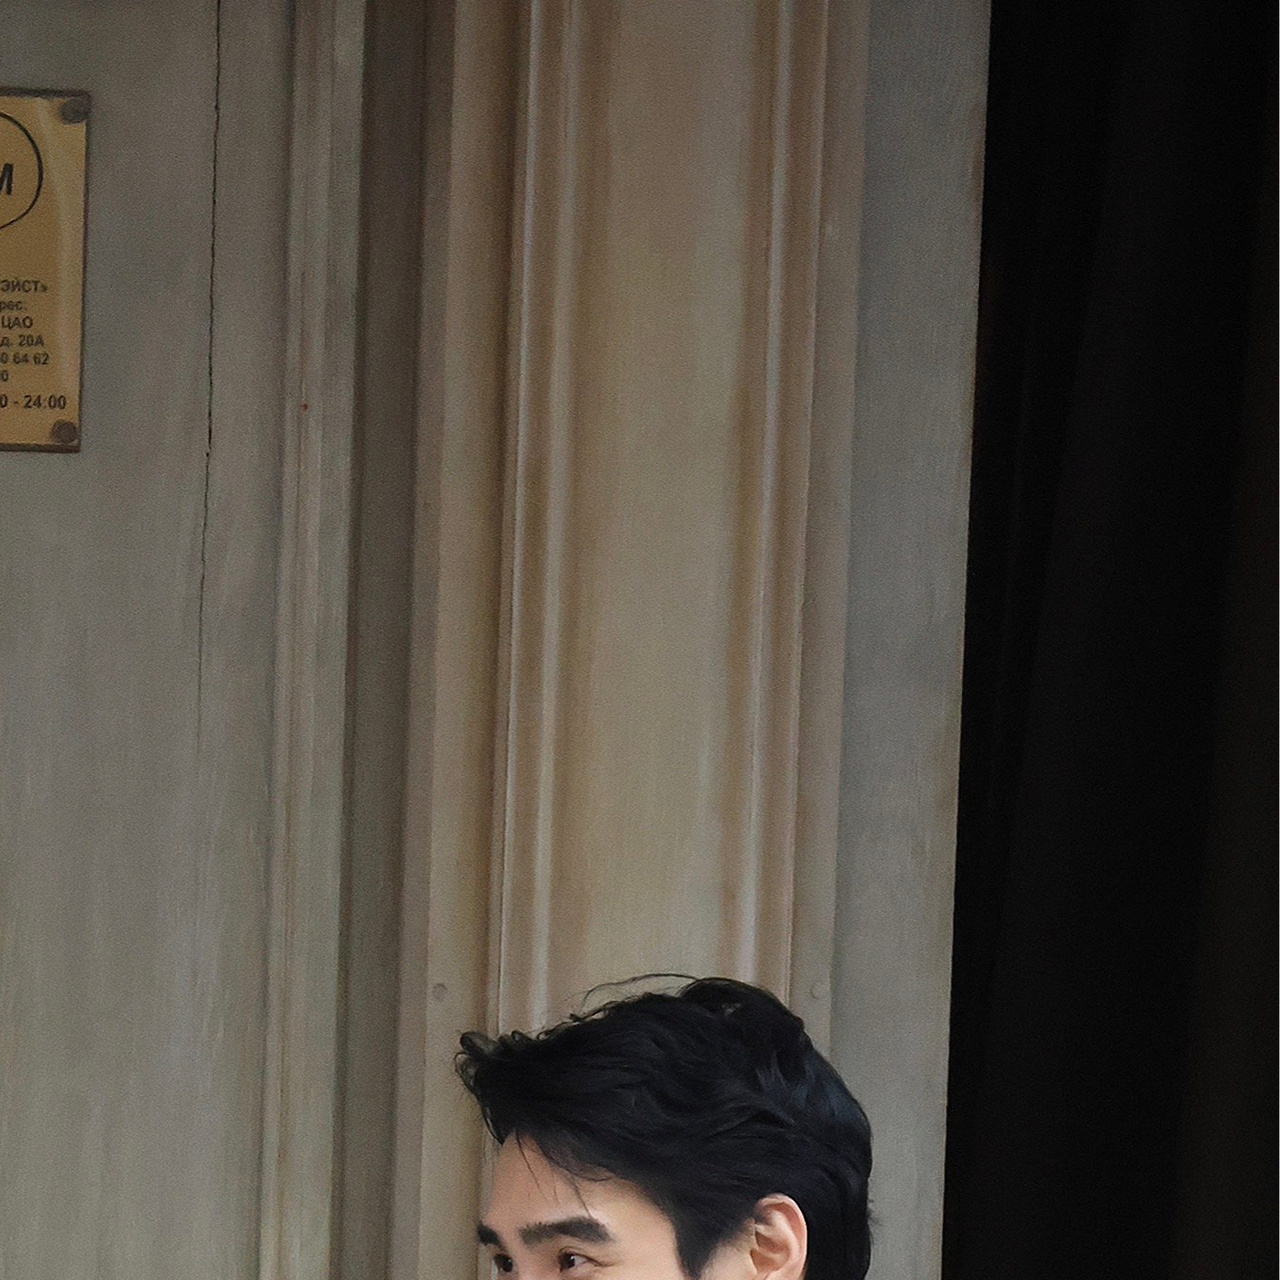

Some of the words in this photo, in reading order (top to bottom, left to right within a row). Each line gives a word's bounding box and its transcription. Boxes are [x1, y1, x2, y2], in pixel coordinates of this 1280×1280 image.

[1, 316, 33, 329] ЦАО
[0, 336, 13, 347] д.
[23, 395, 67, 410] 24:00
